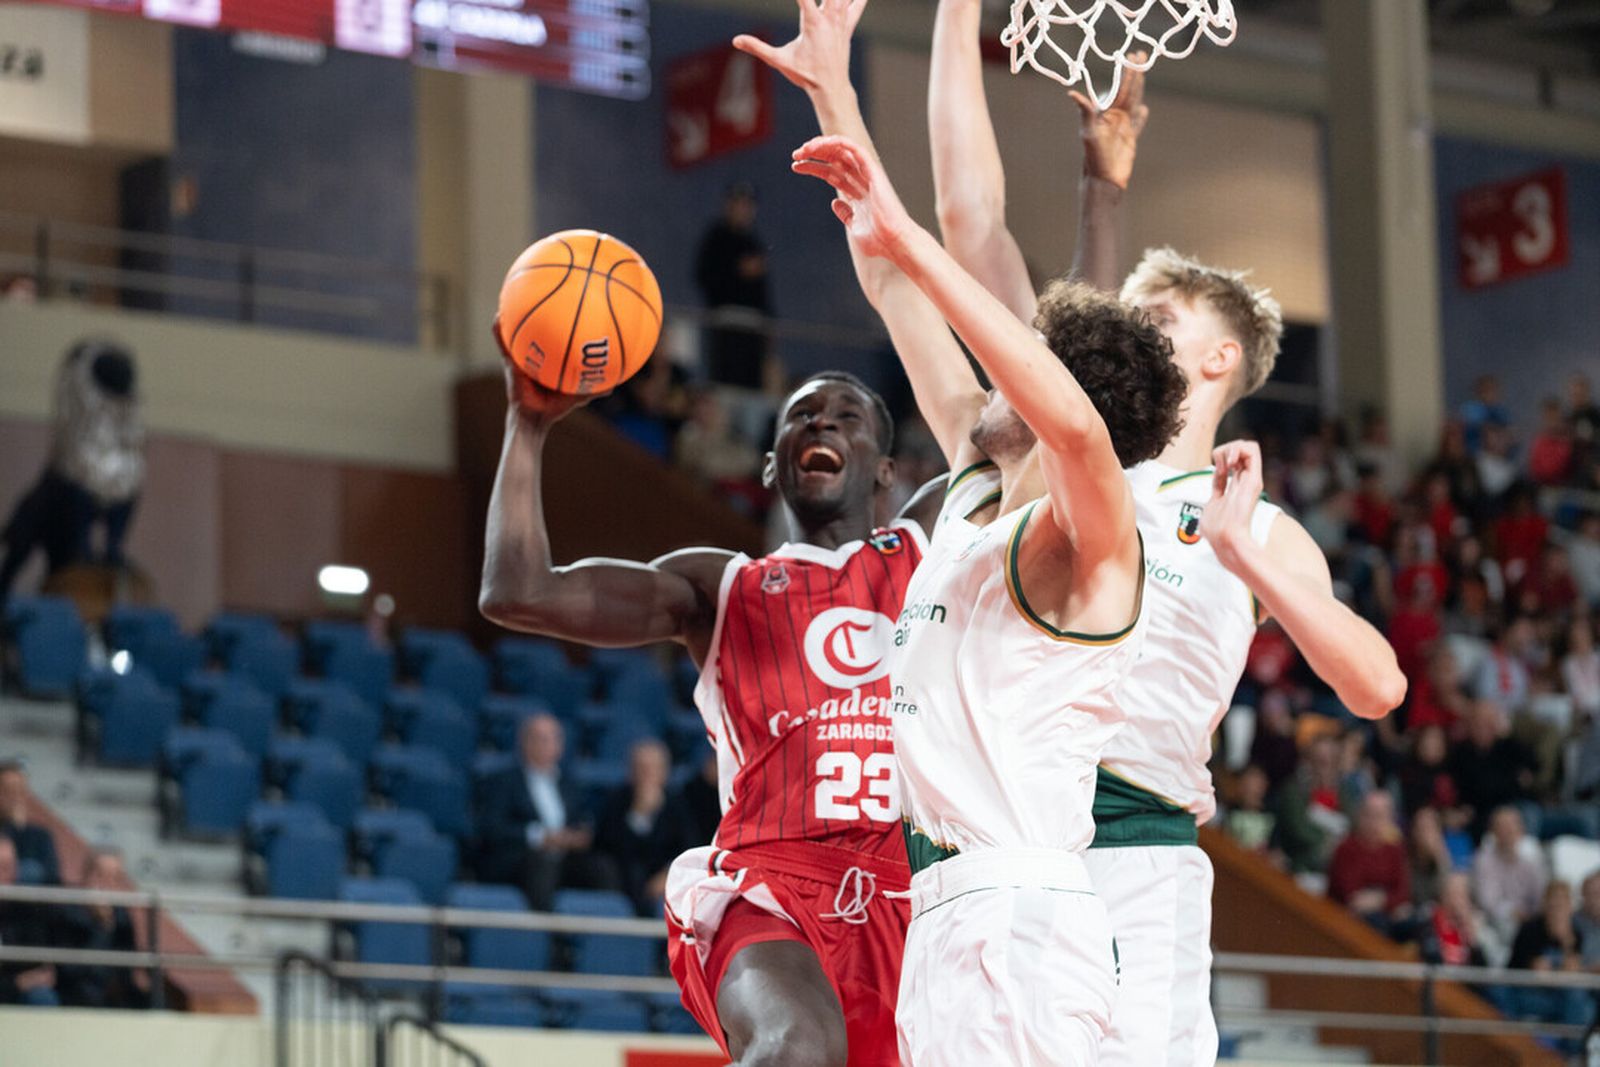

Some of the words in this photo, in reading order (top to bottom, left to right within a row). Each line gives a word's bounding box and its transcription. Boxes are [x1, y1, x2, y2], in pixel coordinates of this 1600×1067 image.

[1512, 183, 1554, 262] 3
[893, 701, 918, 715] rre
[814, 751, 901, 823] 23
